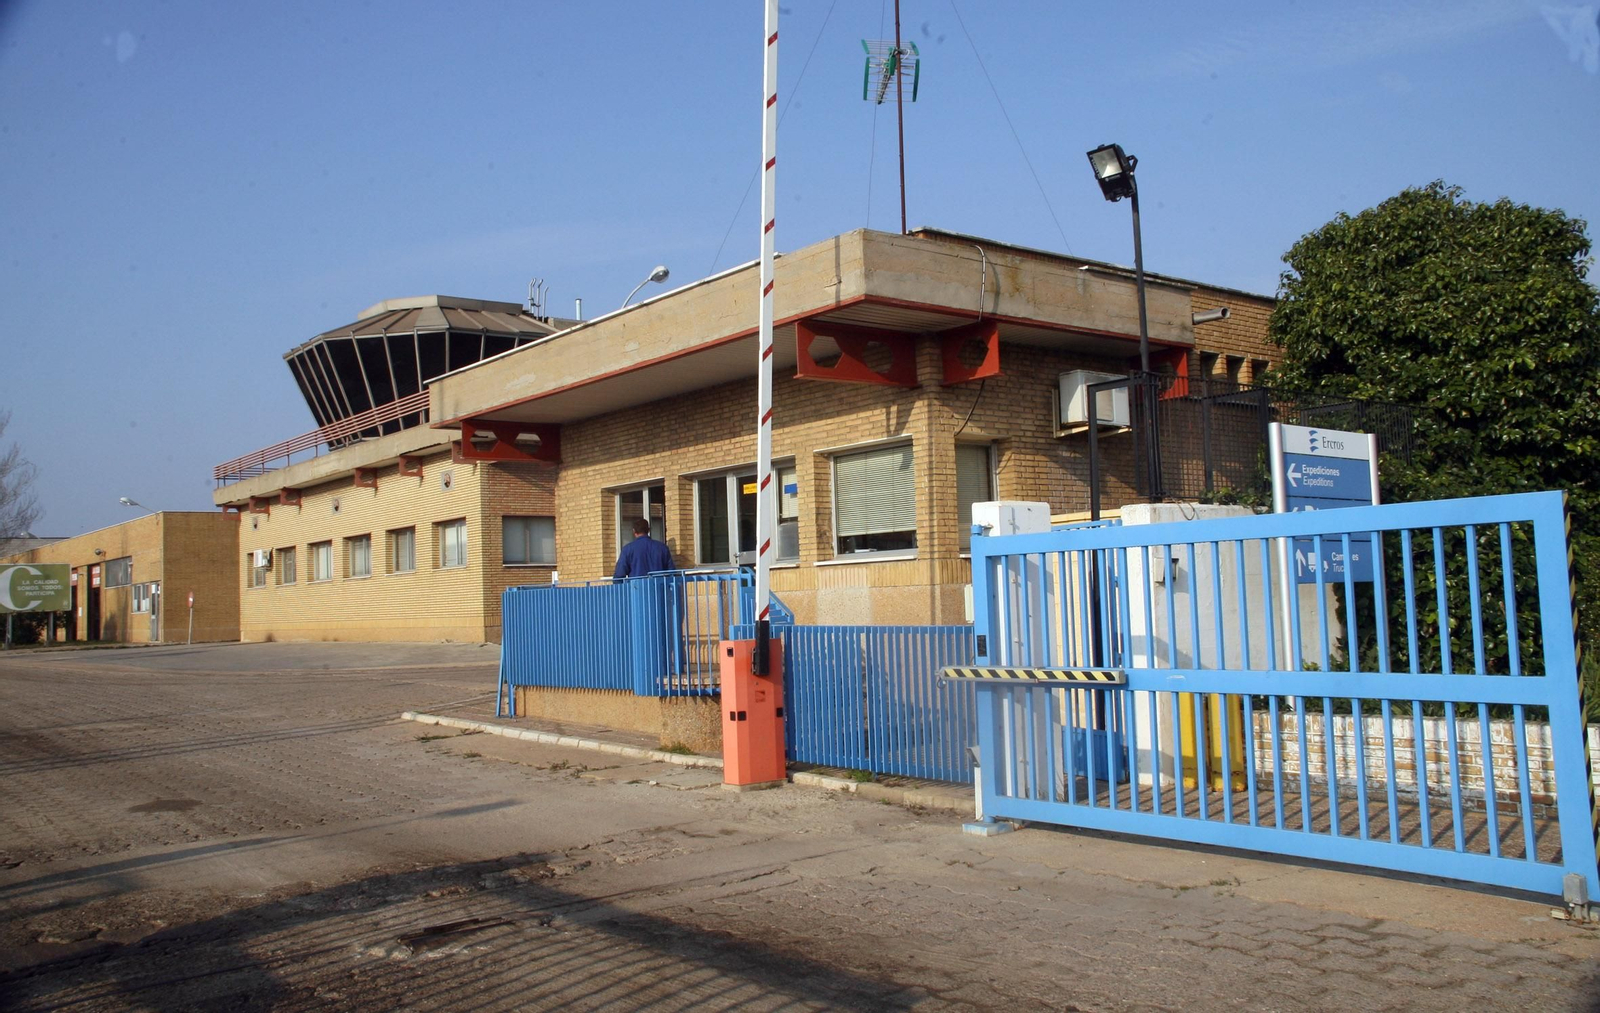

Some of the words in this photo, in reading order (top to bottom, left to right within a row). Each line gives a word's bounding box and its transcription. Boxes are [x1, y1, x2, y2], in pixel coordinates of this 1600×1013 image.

[1322, 436, 1345, 451] Ercros
[1302, 464, 1341, 477] Expediciones
[1303, 476, 1334, 488] Expeditions
